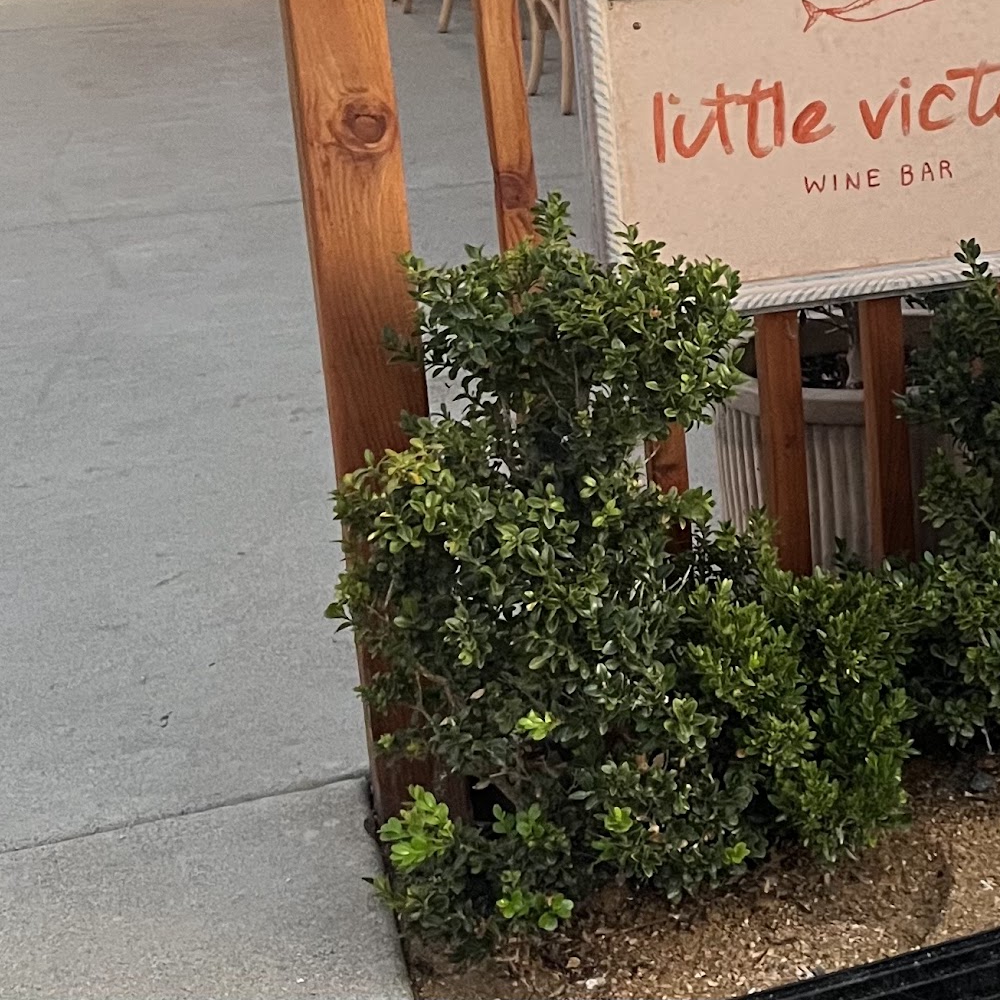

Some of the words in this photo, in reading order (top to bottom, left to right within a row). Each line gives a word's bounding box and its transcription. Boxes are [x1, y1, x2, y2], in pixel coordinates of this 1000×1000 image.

[653, 78, 836, 163] little
[804, 168, 880, 194] WINE
[900, 160, 953, 186] BAR
